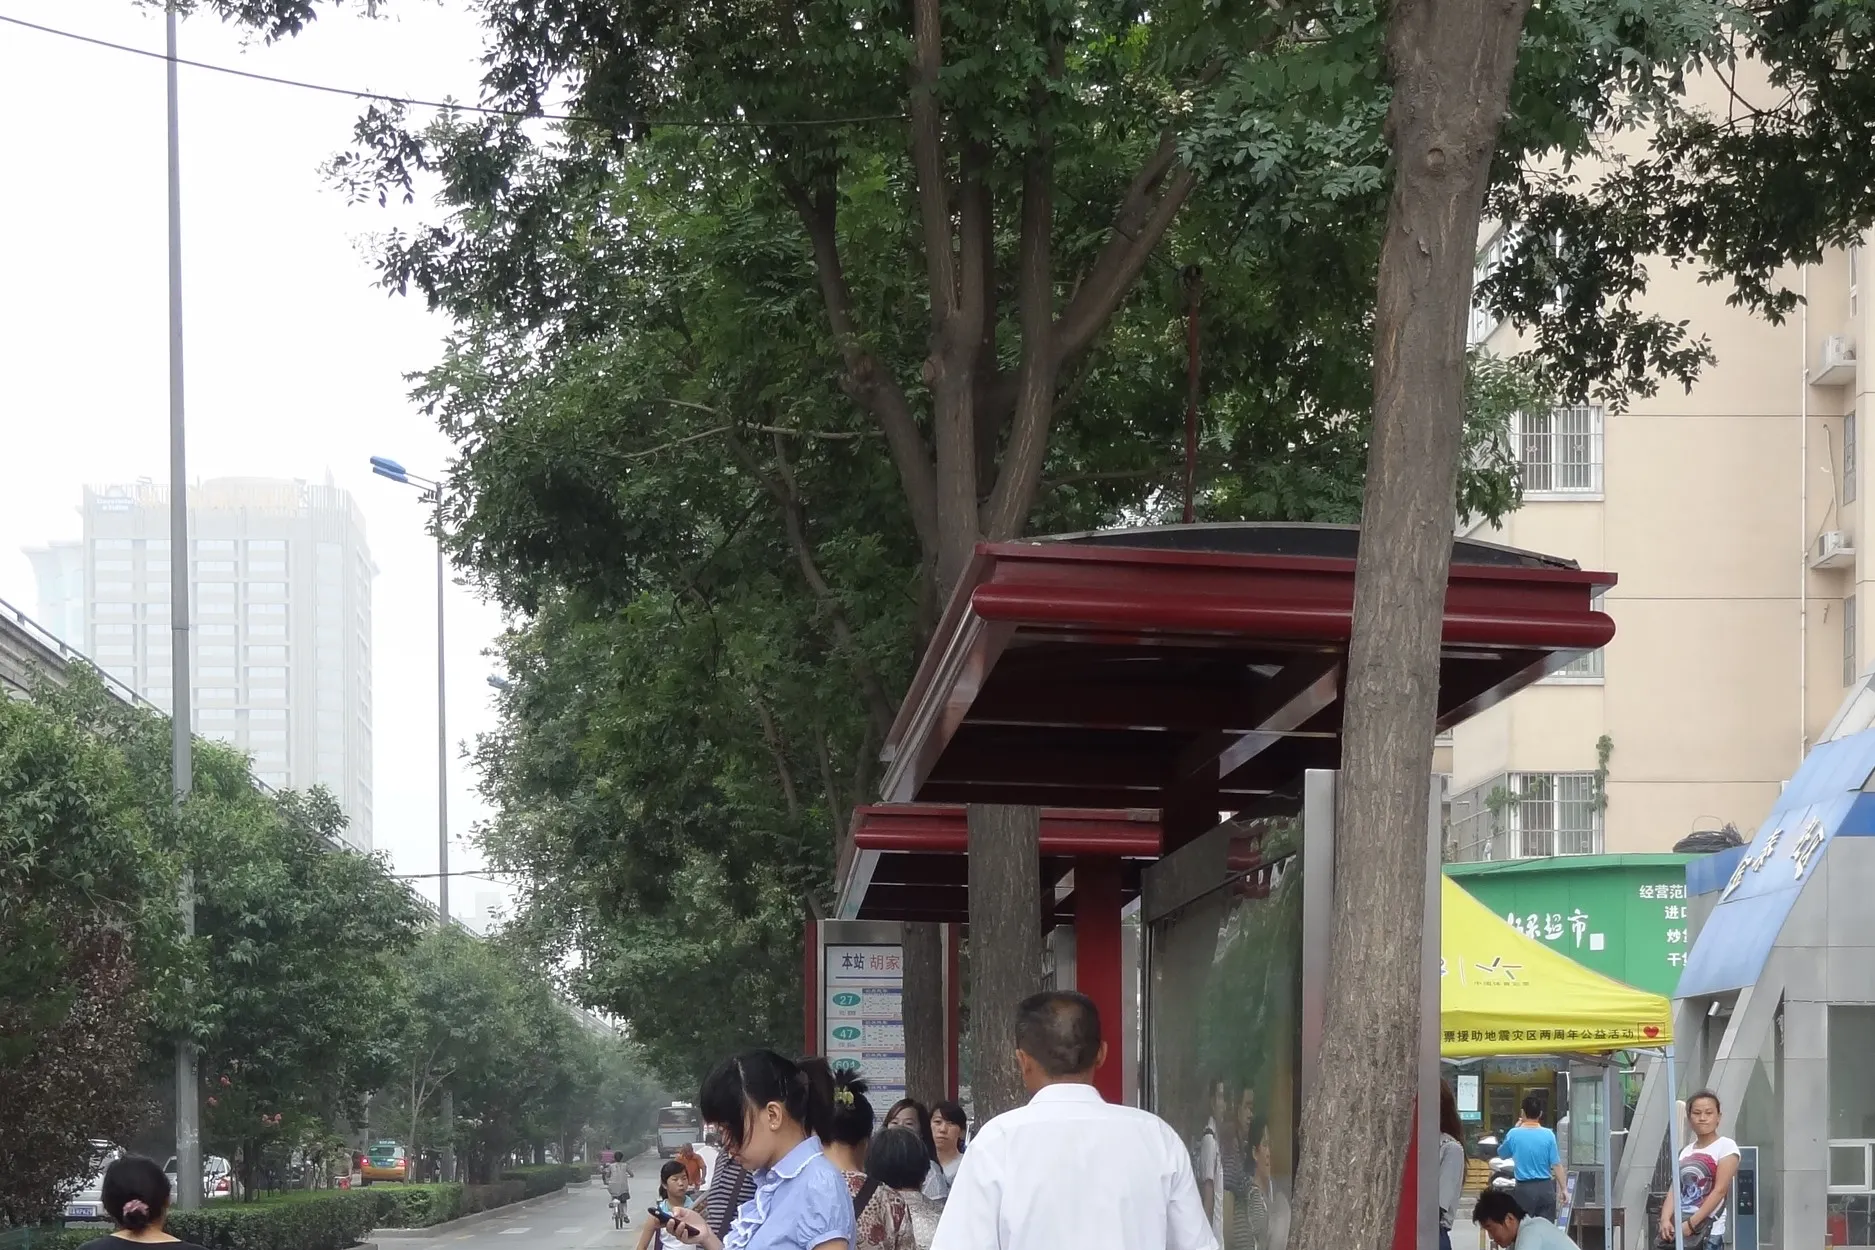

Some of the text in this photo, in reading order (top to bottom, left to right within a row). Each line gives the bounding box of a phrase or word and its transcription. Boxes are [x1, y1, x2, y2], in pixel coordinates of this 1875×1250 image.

[1639, 884, 1687, 899] 经营范
[842, 952, 865, 970] 本站
[840, 995, 853, 1005] 27
[840, 1029, 853, 1038] 47
